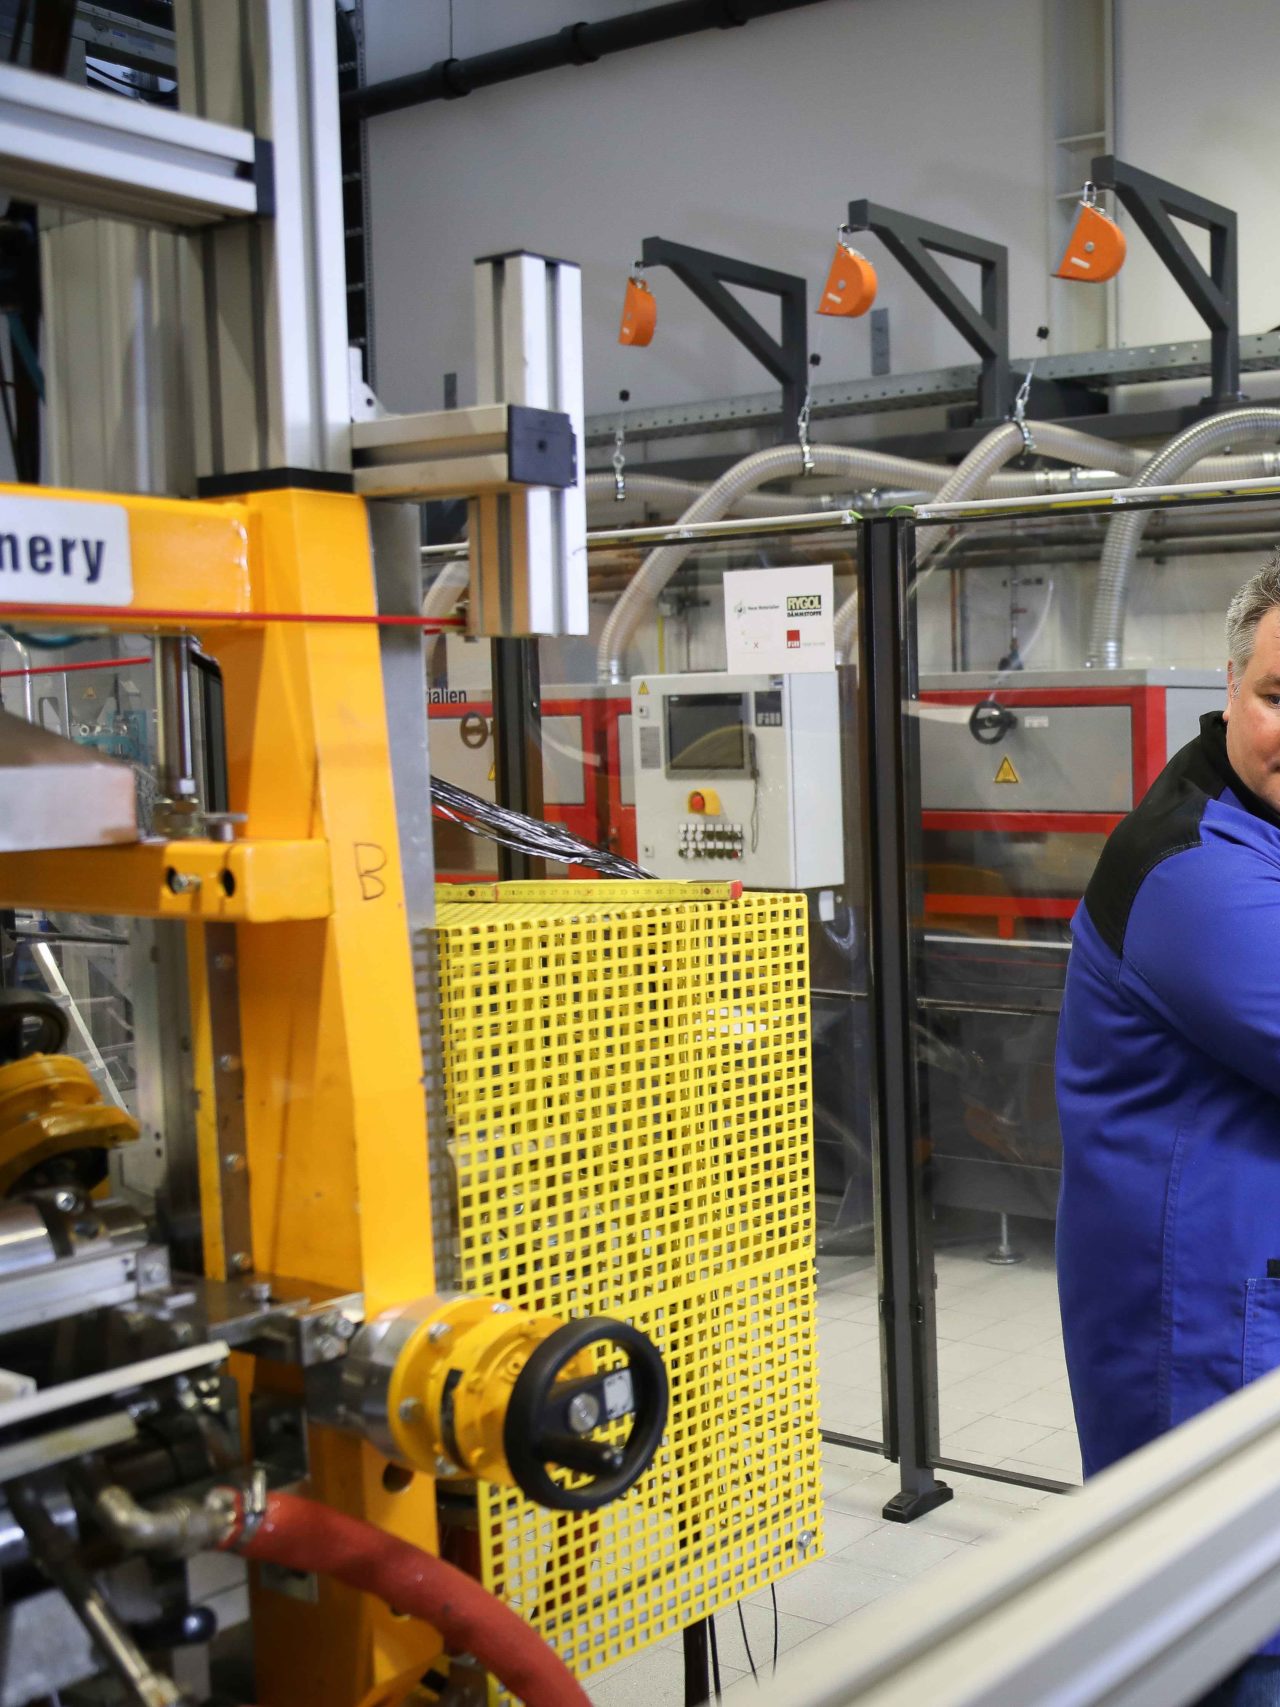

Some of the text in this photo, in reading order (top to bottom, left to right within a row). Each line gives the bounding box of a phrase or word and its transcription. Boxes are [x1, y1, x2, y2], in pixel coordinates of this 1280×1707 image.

[0, 533, 104, 584] nery
[787, 596, 821, 609] RYGOL
[353, 842, 387, 901] B
